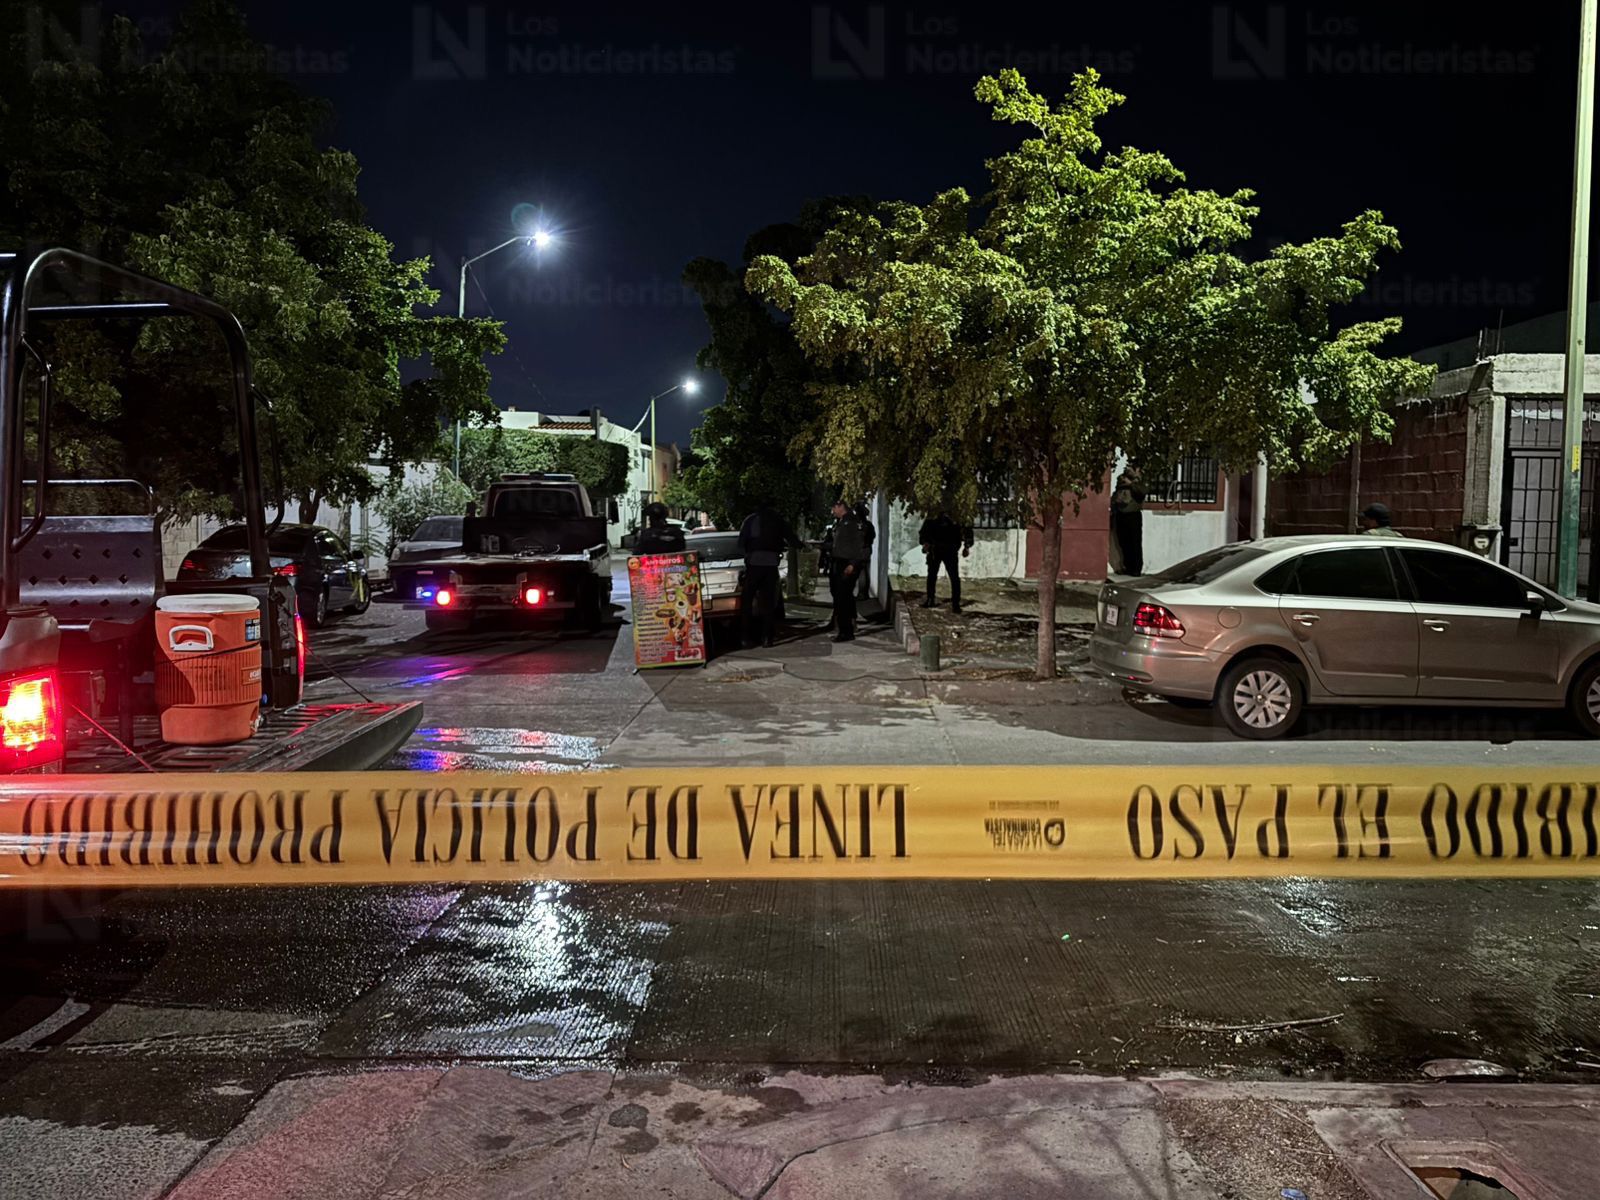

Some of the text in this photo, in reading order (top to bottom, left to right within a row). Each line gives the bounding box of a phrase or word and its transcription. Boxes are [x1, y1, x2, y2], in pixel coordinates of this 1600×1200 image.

[21, 783, 909, 866] LINEA DE POLICIA PROHIBIDO
[1128, 783, 1294, 860] PASO
[1318, 783, 1392, 859] EL
